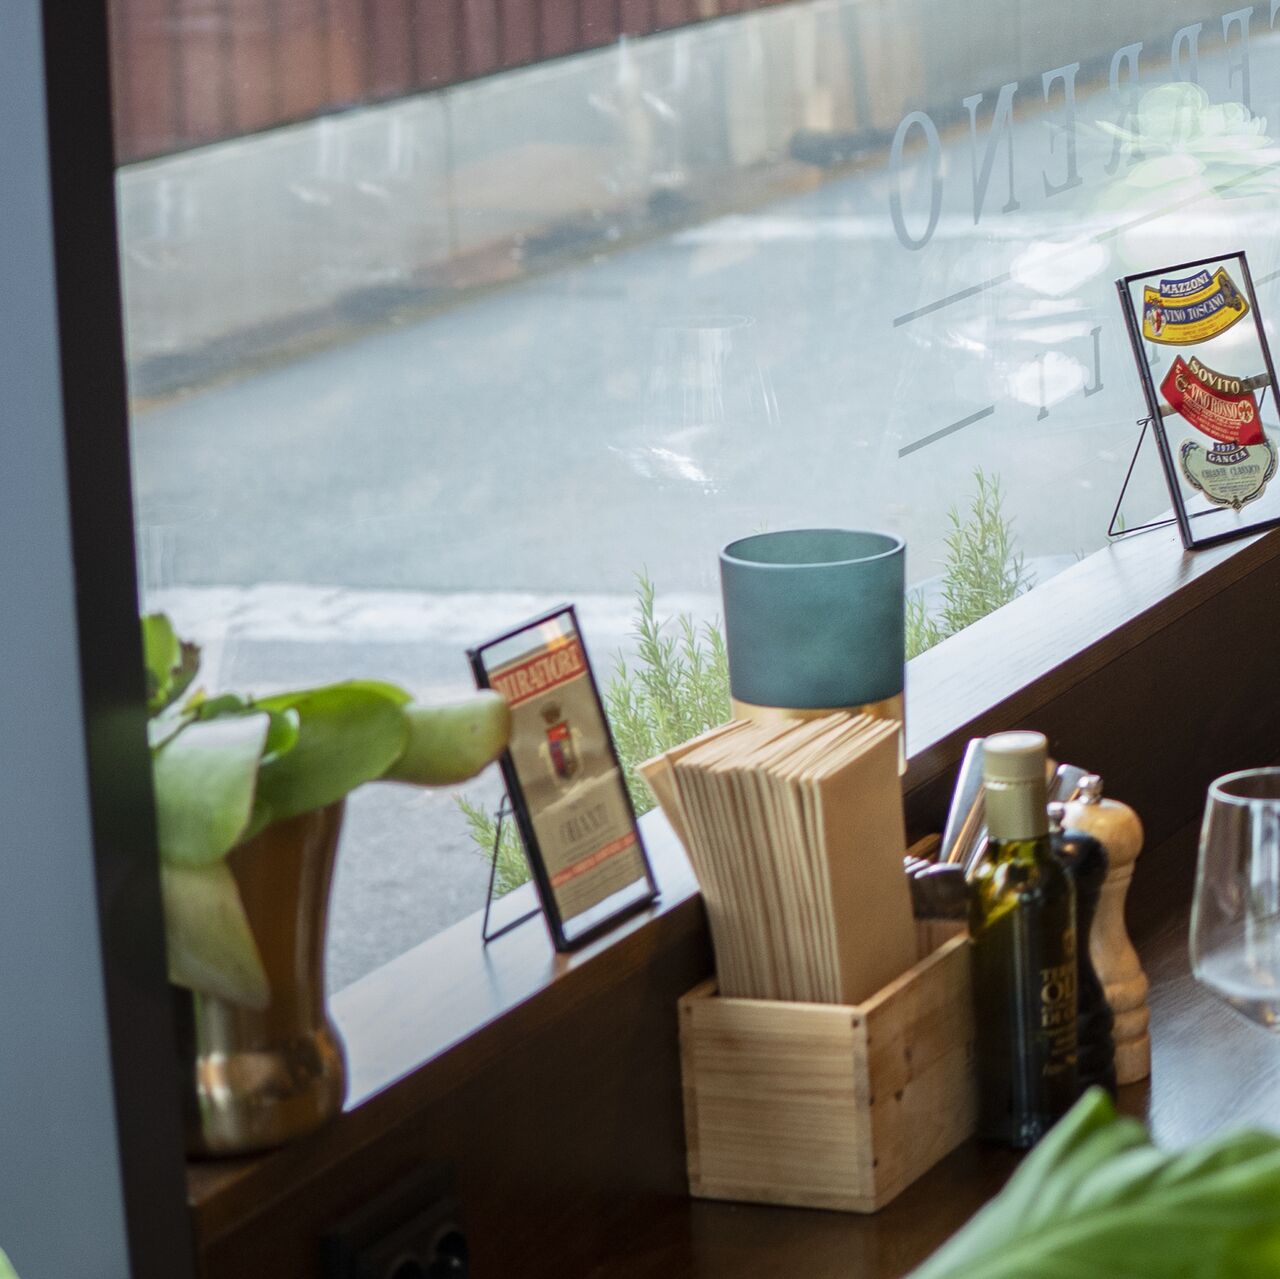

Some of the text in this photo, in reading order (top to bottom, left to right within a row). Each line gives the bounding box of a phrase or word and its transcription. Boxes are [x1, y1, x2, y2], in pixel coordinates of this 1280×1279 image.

[1161, 272, 1209, 294] MAZZONI
[1163, 308, 1186, 322] VINO
[1188, 293, 1224, 320] TOSCANO
[1190, 359, 1240, 394] SOVITO
[1191, 385, 1211, 409] VINO
[1211, 397, 1238, 419] ROSSO
[1207, 450, 1247, 463] GANCIA
